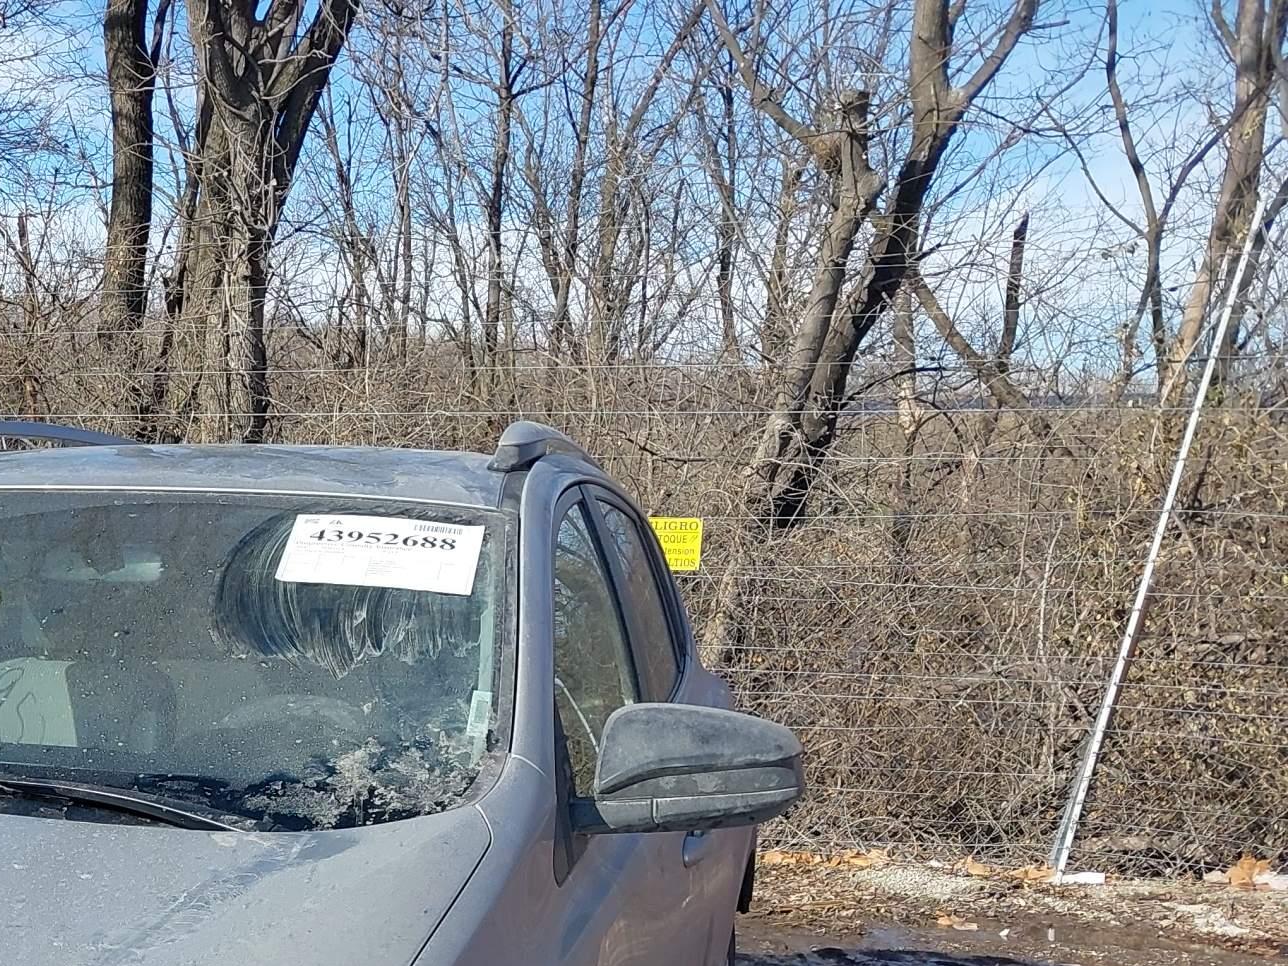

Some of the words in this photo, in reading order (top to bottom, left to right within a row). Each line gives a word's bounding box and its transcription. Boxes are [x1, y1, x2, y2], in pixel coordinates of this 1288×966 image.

[651, 521, 699, 531] LIGRO
[309, 528, 457, 551] 43952688
[668, 557, 697, 567] LTIOS
